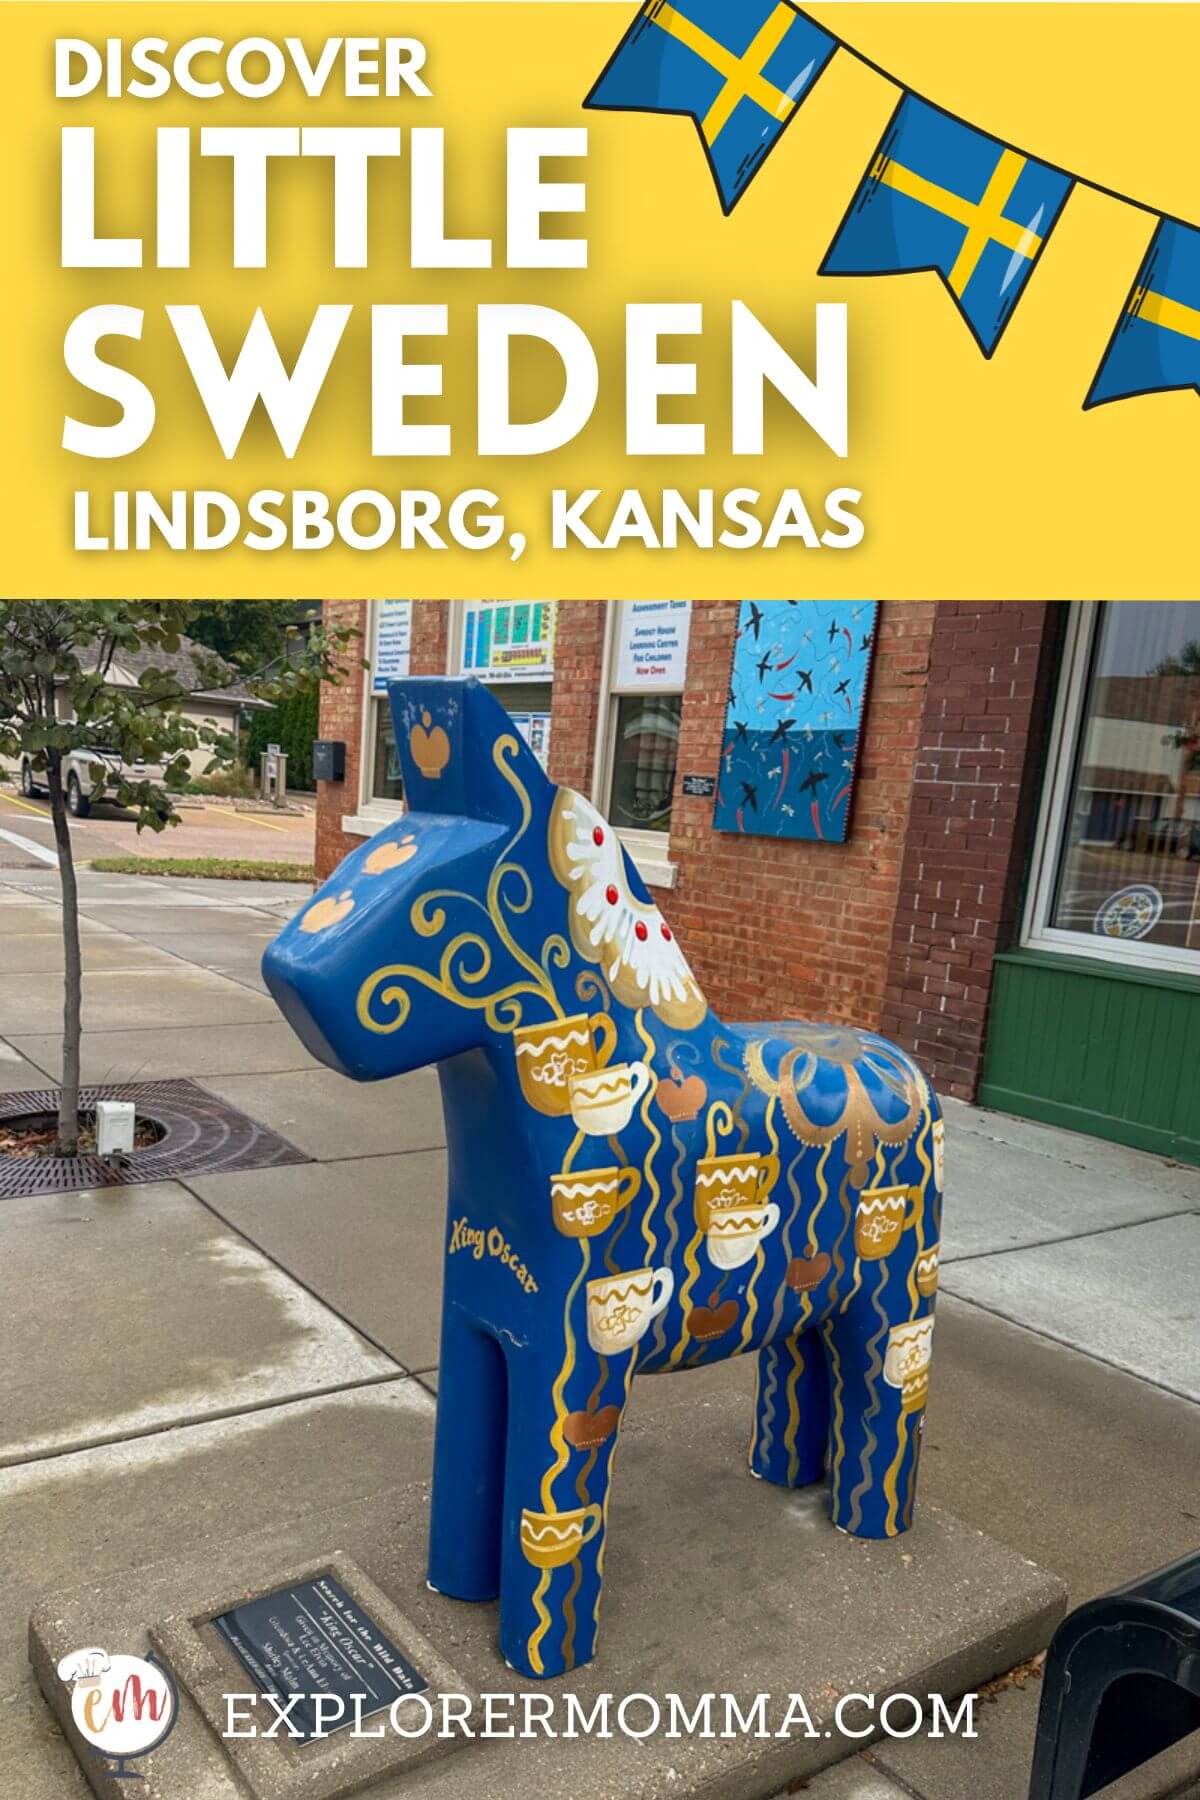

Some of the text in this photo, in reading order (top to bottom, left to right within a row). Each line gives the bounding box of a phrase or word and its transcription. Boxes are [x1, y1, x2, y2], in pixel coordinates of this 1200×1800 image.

[448, 1216, 539, 1294] King Oscar
[319, 1581, 345, 1608] Search
[343, 1610, 358, 1624] for
[357, 1626, 372, 1641] the
